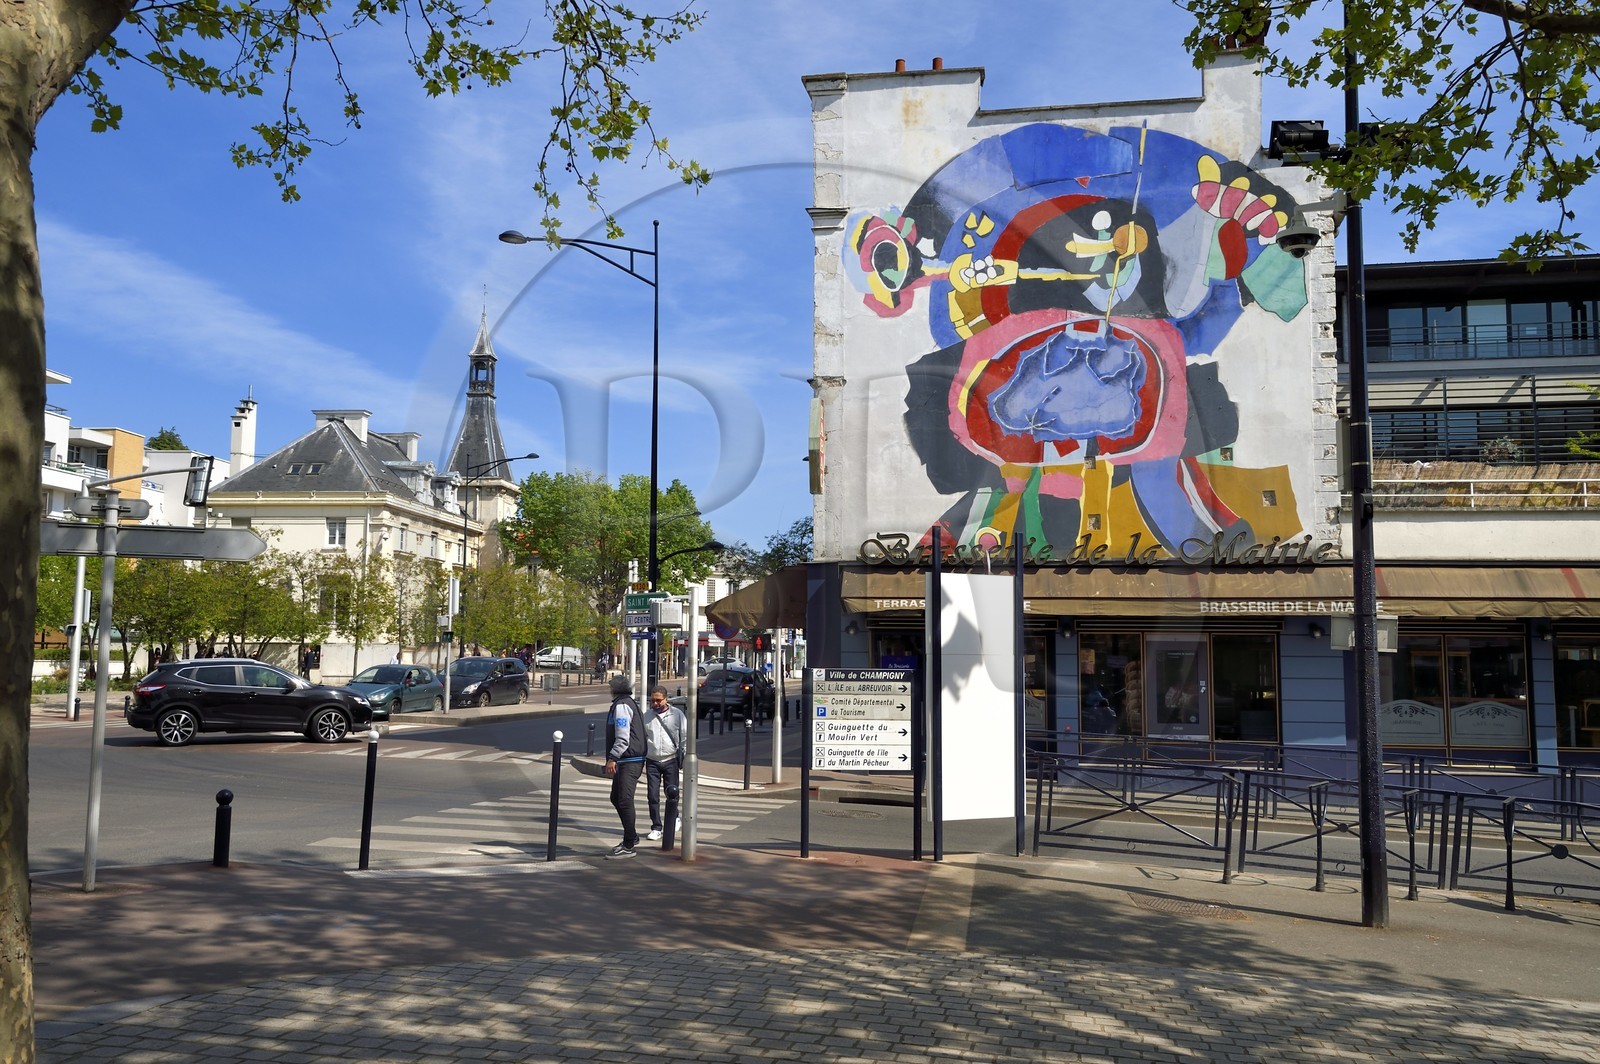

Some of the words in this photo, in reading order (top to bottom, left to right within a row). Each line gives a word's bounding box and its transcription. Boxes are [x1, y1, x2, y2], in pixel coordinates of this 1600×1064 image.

[856, 532, 1054, 565] Brasserie
[1065, 533, 1109, 565] de
[1125, 532, 1163, 565] la
[1177, 530, 1333, 565] Mairie
[874, 599, 926, 609] TERRAS
[1200, 601, 1280, 613] BRASSERIE
[1284, 602, 1304, 613] DE
[1308, 602, 1327, 613] LA
[1331, 601, 1384, 613] MAE
[829, 671, 846, 679] Ville
[848, 671, 858, 679] de
[859, 671, 905, 680] CHAMPIGNY
[831, 698, 851, 706] Comité
[853, 698, 895, 707] Départemental
[831, 708, 838, 716] du
[840, 708, 866, 716] Tourisme
[828, 723, 874, 732] Guinguette
[878, 723, 888, 731] du
[828, 749, 864, 758] Guinguette
